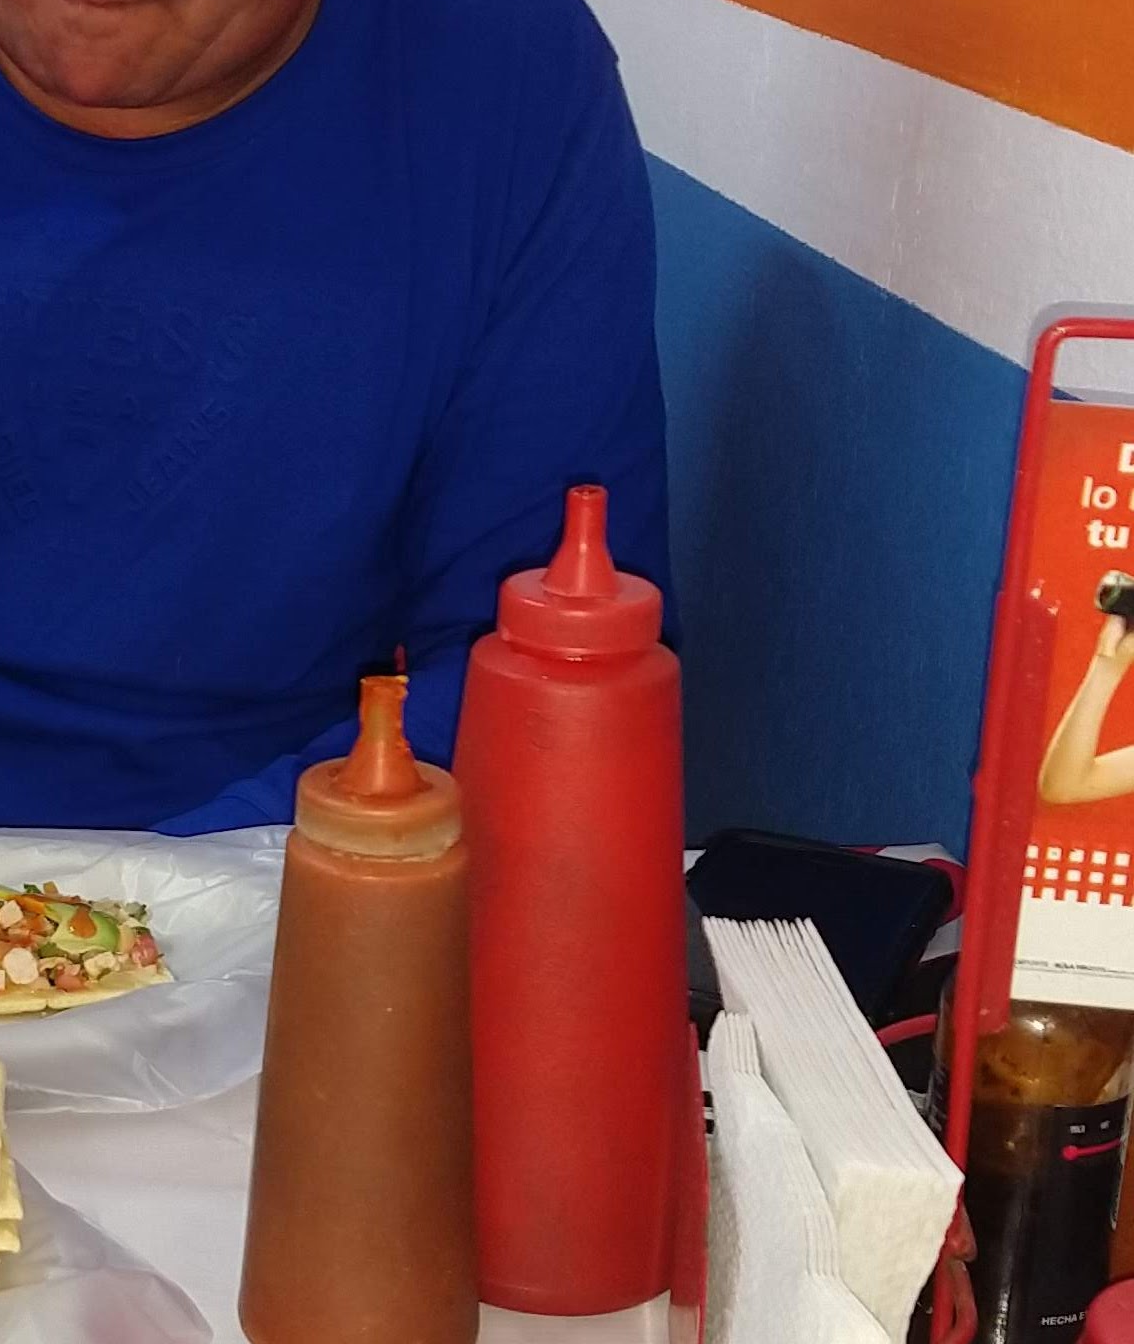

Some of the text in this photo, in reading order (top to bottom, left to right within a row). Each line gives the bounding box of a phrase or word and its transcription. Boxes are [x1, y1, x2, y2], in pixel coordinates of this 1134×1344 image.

[1081, 475, 1118, 510] lo
[1085, 518, 1130, 549] tu
[1040, 1313, 1078, 1326] HECHA
